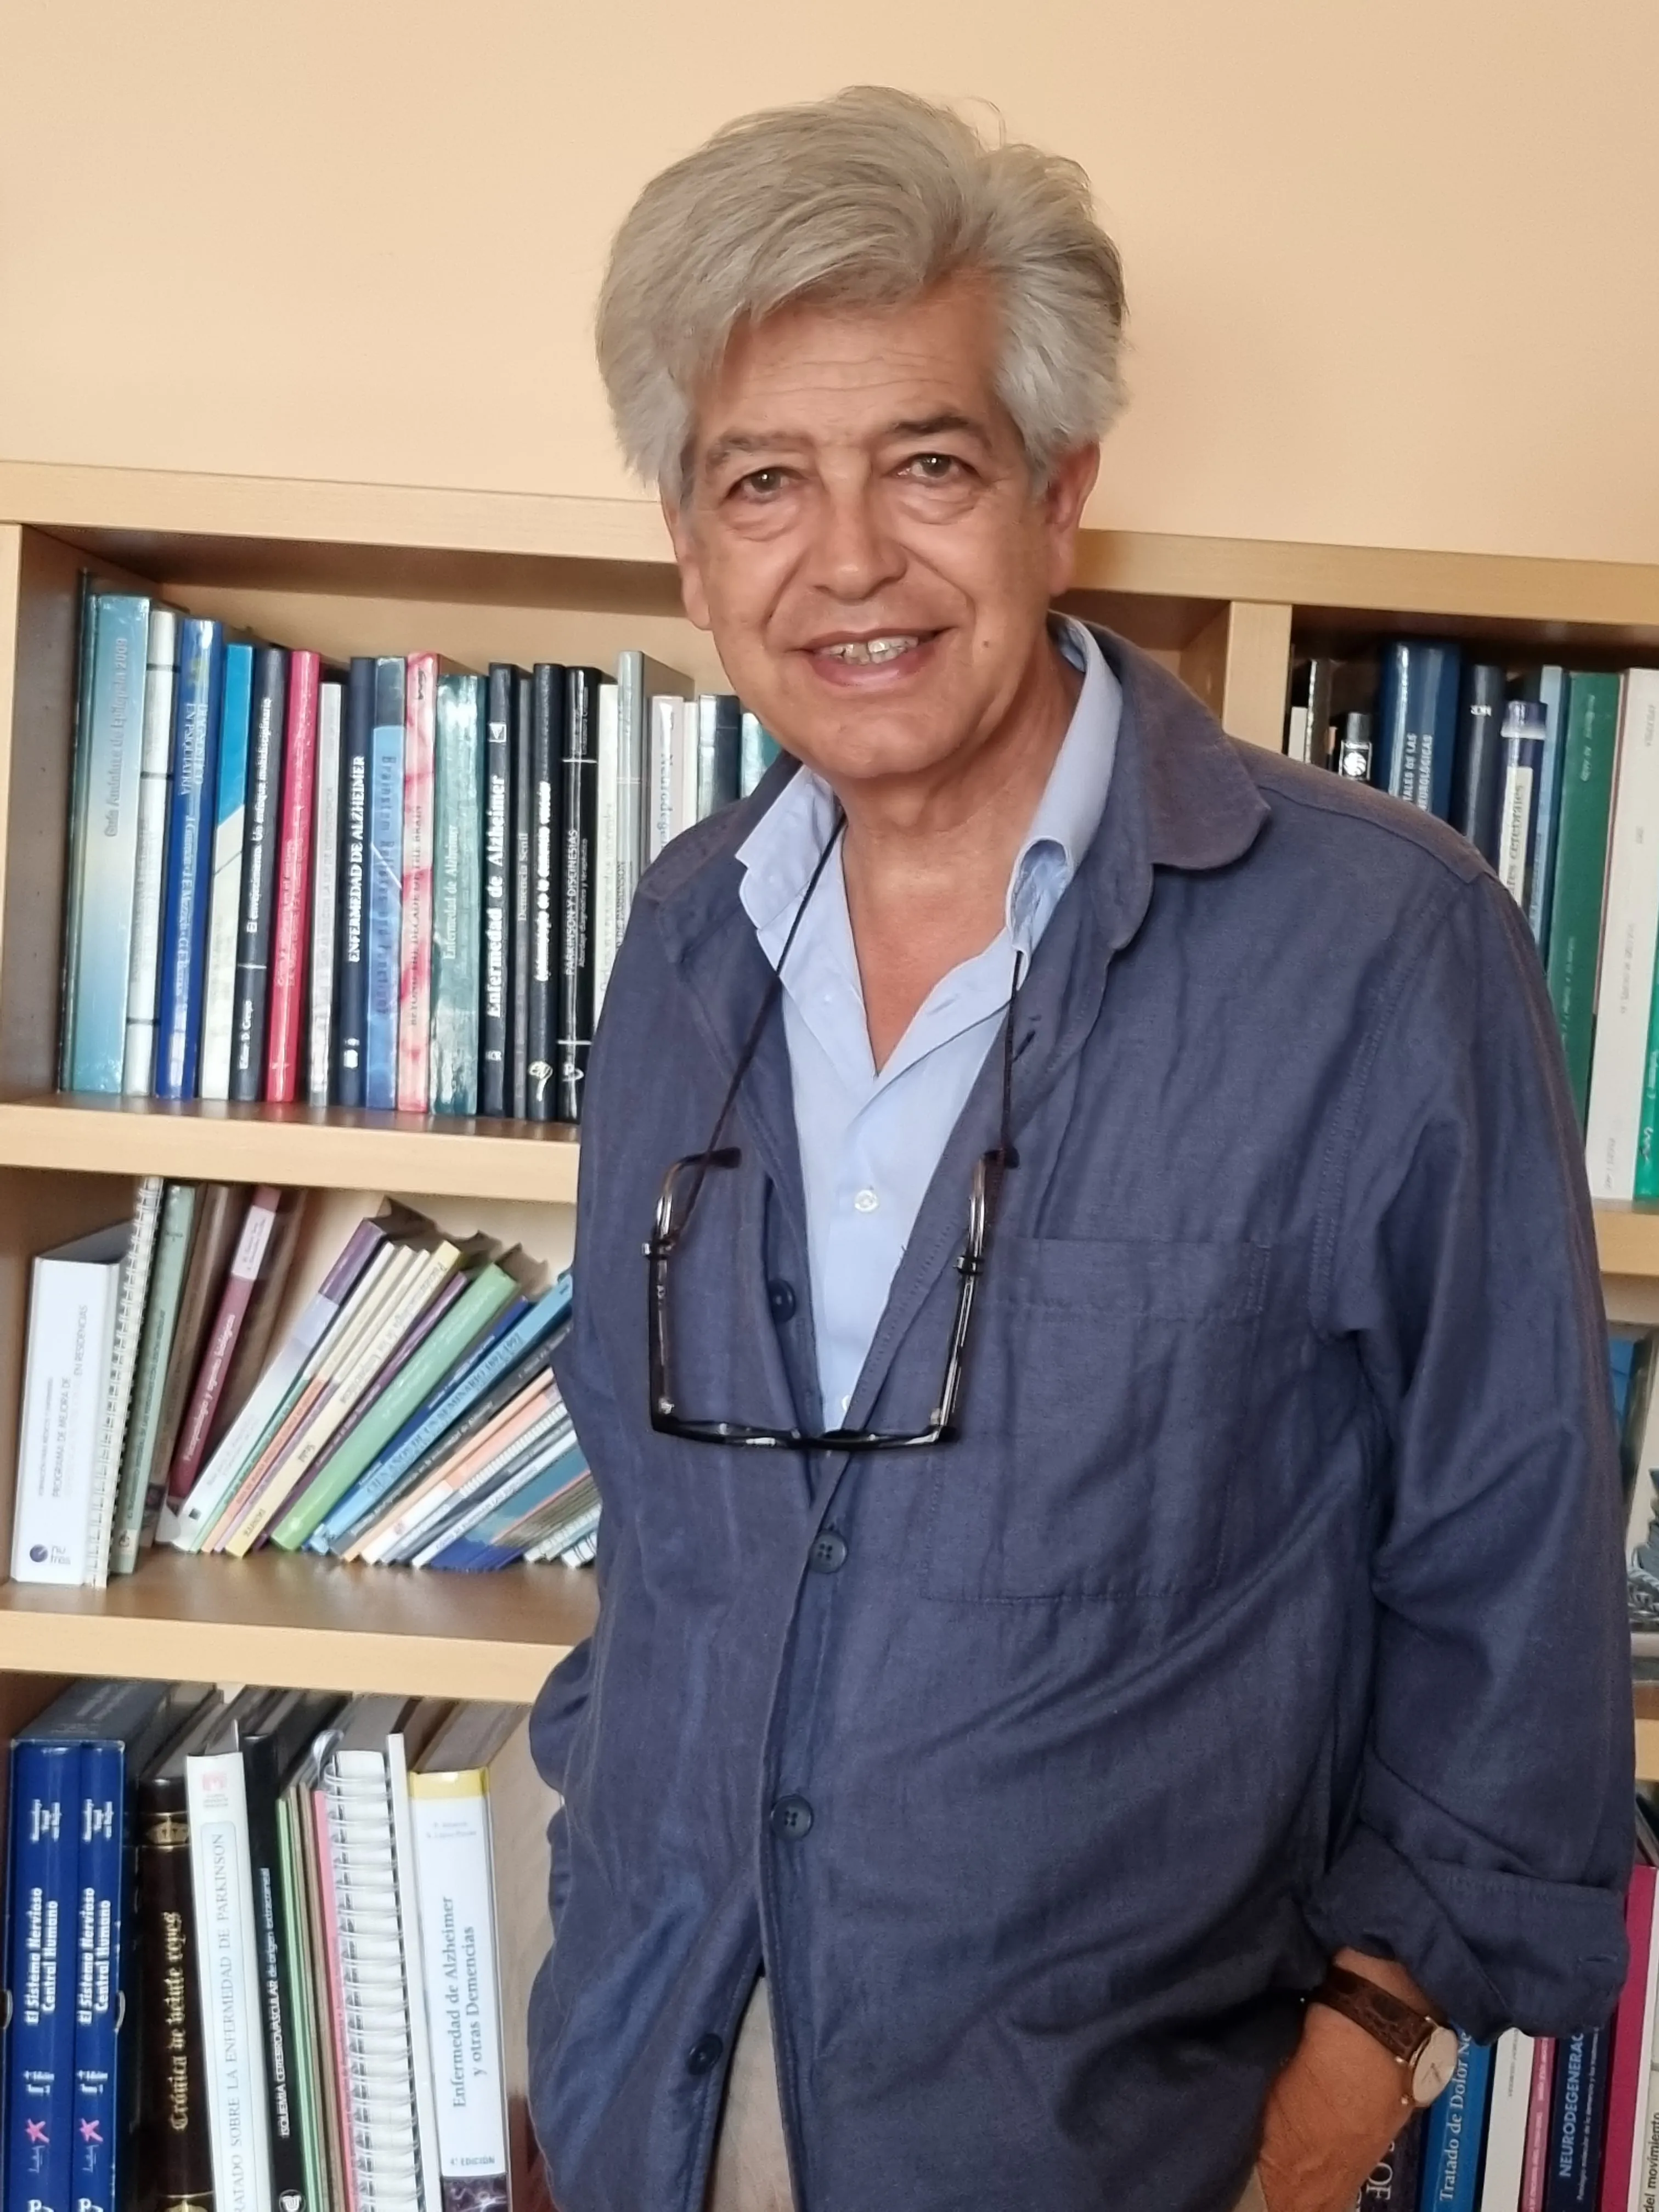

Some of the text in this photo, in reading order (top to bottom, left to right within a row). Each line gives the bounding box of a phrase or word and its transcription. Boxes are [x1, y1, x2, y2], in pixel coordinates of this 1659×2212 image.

[115, 639, 127, 670] 2009
[257, 698, 272, 780] multidisciplinario
[1405, 732, 1417, 753] LAS
[250, 825, 263, 841] Un
[253, 783, 267, 823] enfoque
[414, 805, 422, 842] BRAIN
[348, 756, 365, 962] ENFERMEDAD DE ALZHEIMER
[413, 847, 421, 870] THE
[443, 824, 459, 960] Enfermedad de Alzheimer
[486, 775, 505, 1018] Enfermedad de Alzheimer
[517, 832, 528, 921] Demencia Senil
[247, 922, 258, 933] El
[411, 896, 420, 945] DECADE
[566, 829, 578, 976] PARKINSON Y DISCINESIAS
[410, 949, 419, 972] THE
[72, 1305, 88, 1376] EN RESIDENCIAS
[51, 1376, 70, 1498] PROGRAMA DE MEJORA DE
[409, 1431, 425, 1448] DE
[435, 1368, 488, 1421] SEMINARIO
[24, 1887, 43, 2024] El Sistema Nervioso
[41, 1900, 58, 2012] Central Humano
[77, 1887, 95, 2024] El Sistema Nervioso
[94, 1900, 111, 2012] Central Humano
[163, 1912, 187, 1963] reyes
[166, 2029, 186, 2051] de
[212, 1833, 245, 2212] RATADO SOBRE LA ENFERMEDAD DE PARKINSON
[260, 1867, 290, 2136] ISQUEMIA CEREBROVASCULAR de origen extracraneal
[440, 1895, 467, 2108] Enfermedad de Alzheimer
[460, 1925, 487, 2076] y otras Demencias
[167, 2056, 188, 2131] Crónica
[1439, 2031, 1472, 2201] Tratado de Dolor Ne
[1559, 2033, 1584, 2177] NEURODEGENERAC
[1645, 2112, 1659, 2189] movimiento
